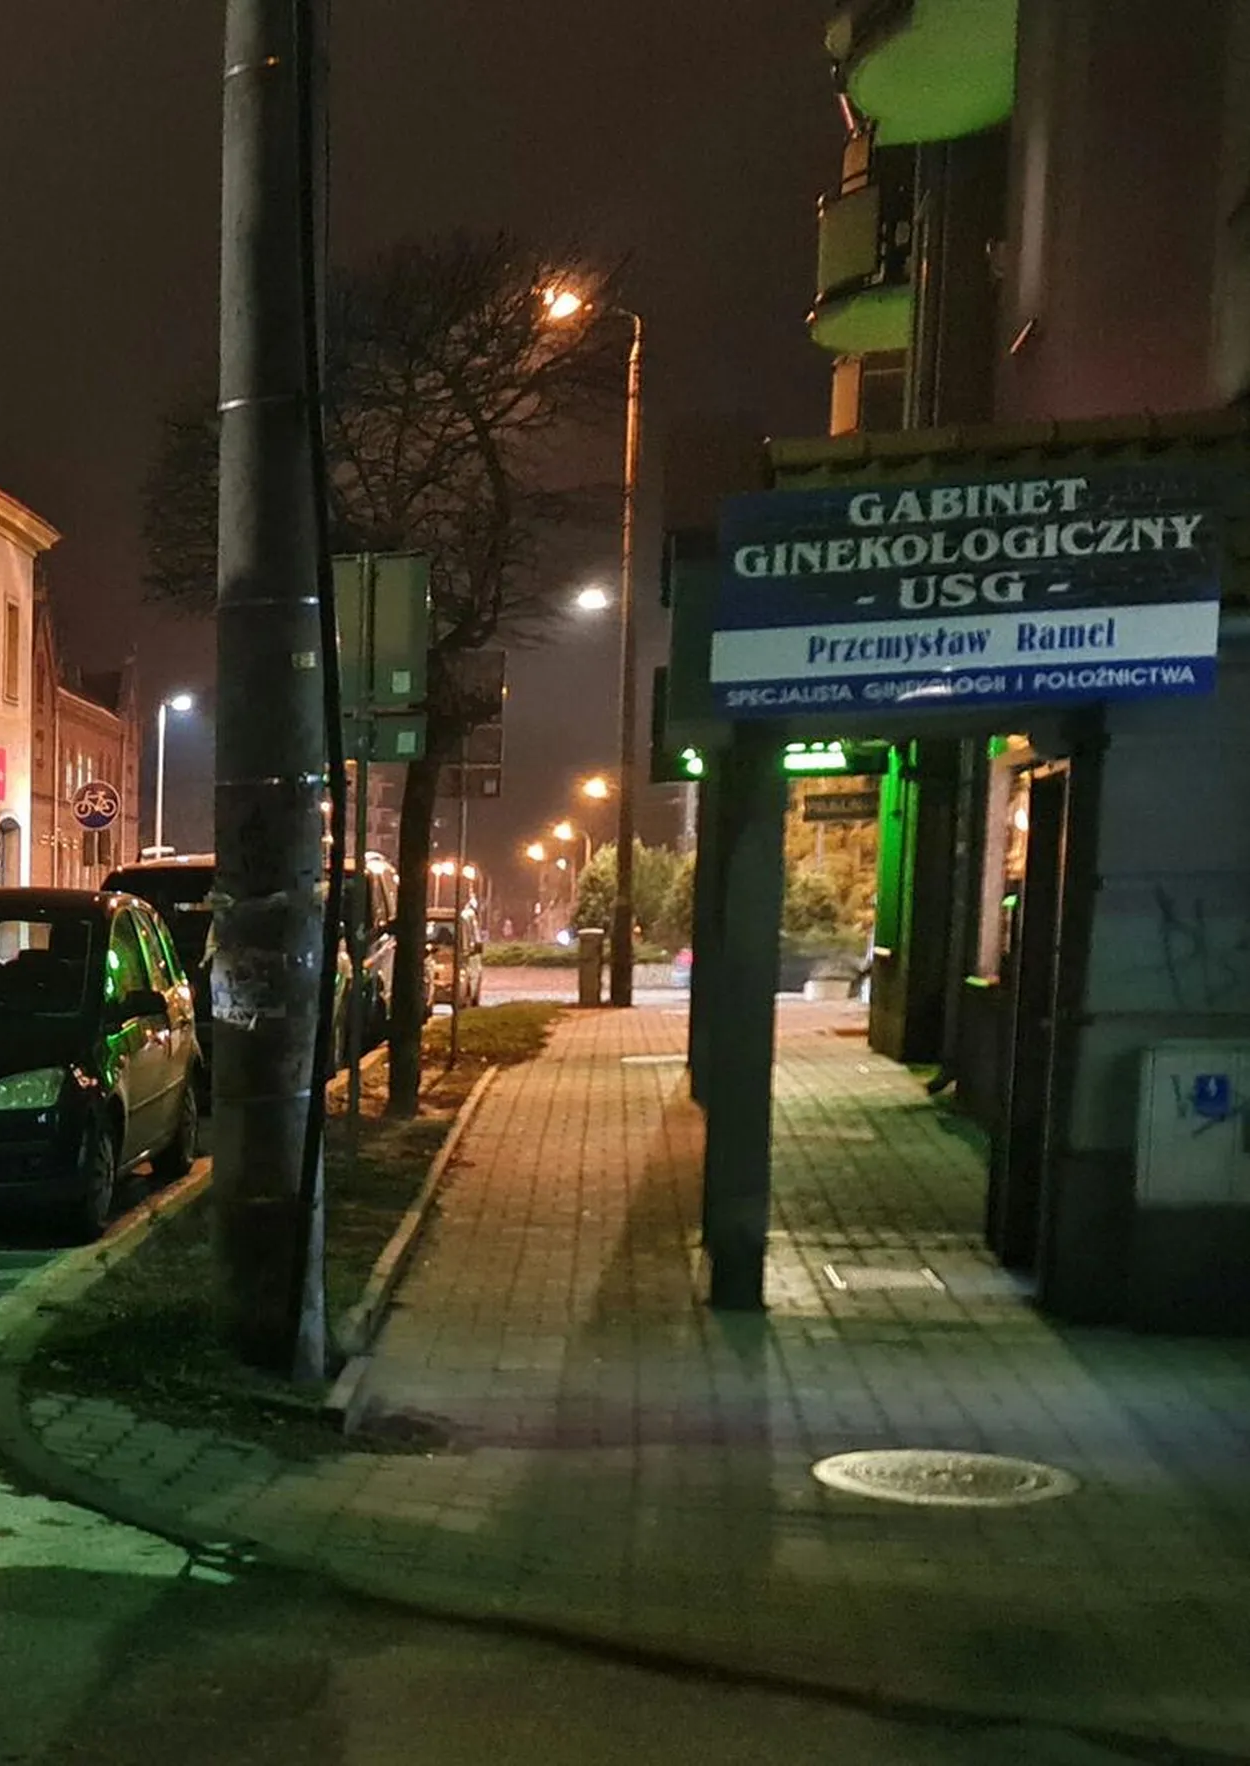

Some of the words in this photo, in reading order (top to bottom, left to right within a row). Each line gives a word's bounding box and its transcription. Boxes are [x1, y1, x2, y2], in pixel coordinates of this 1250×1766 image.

[850, 478, 1088, 527] GABINET
[734, 515, 1202, 577] GINEKOLOGICZNY
[899, 571, 1026, 610] USG
[726, 682, 853, 707] SPECJALISTA
[1034, 663, 1196, 692] POŁOŻNICTWA
